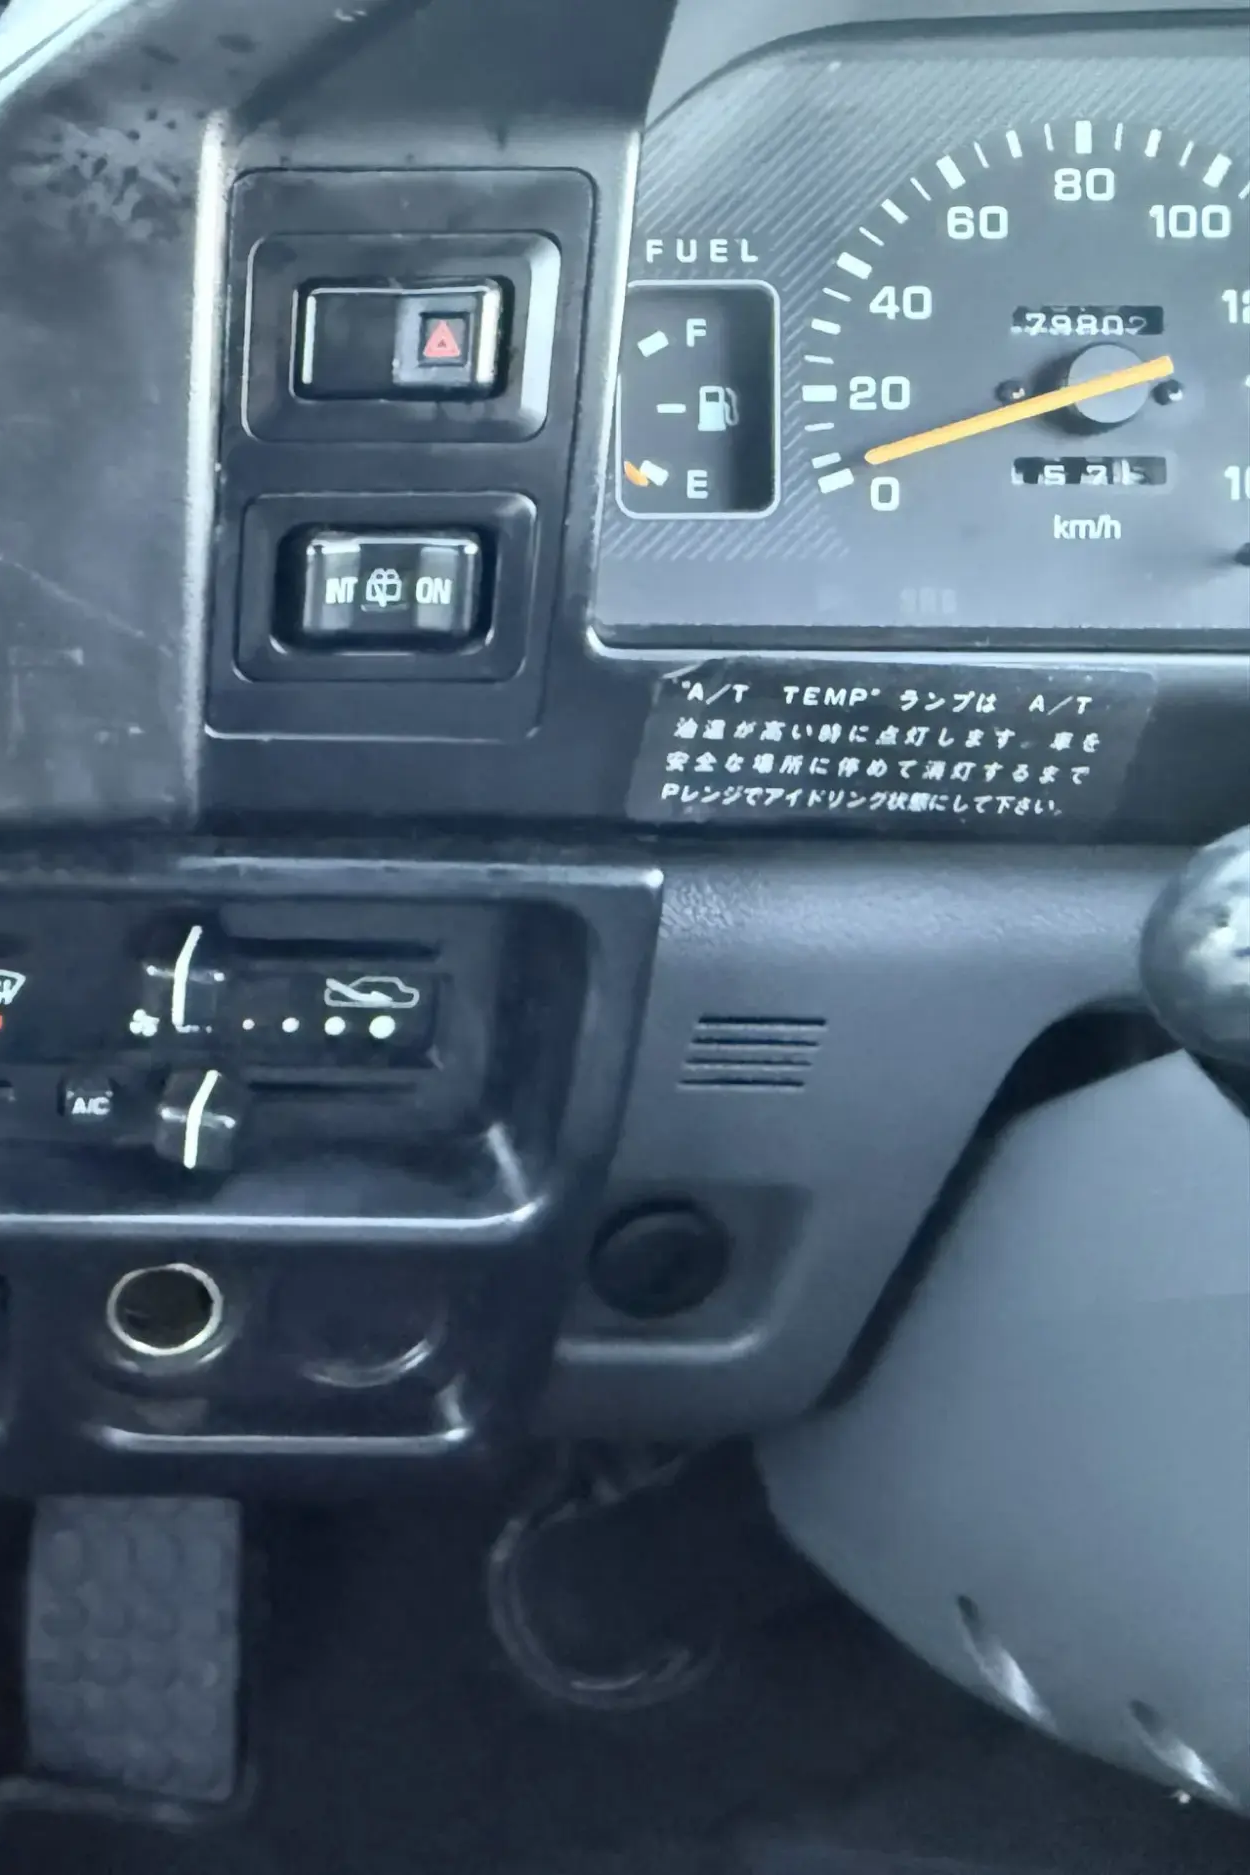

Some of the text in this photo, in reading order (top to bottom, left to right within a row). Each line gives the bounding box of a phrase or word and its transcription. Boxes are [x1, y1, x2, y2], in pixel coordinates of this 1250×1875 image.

[1053, 167, 1115, 202] 80
[946, 205, 1009, 240] 60
[1148, 204, 1231, 239] 100
[645, 238, 759, 263] FUEL
[869, 285, 933, 320] 40
[686, 318, 707, 348] F
[849, 375, 911, 411] 20
[686, 469, 709, 499] E
[870, 476, 900, 512] 0
[1053, 513, 1122, 540] km/h
[325, 576, 359, 605] INT
[415, 576, 453, 605] ON
[899, 689, 998, 714] ランプは
[1028, 694, 1093, 716] A/T
[72, 1096, 111, 1116] A/C
